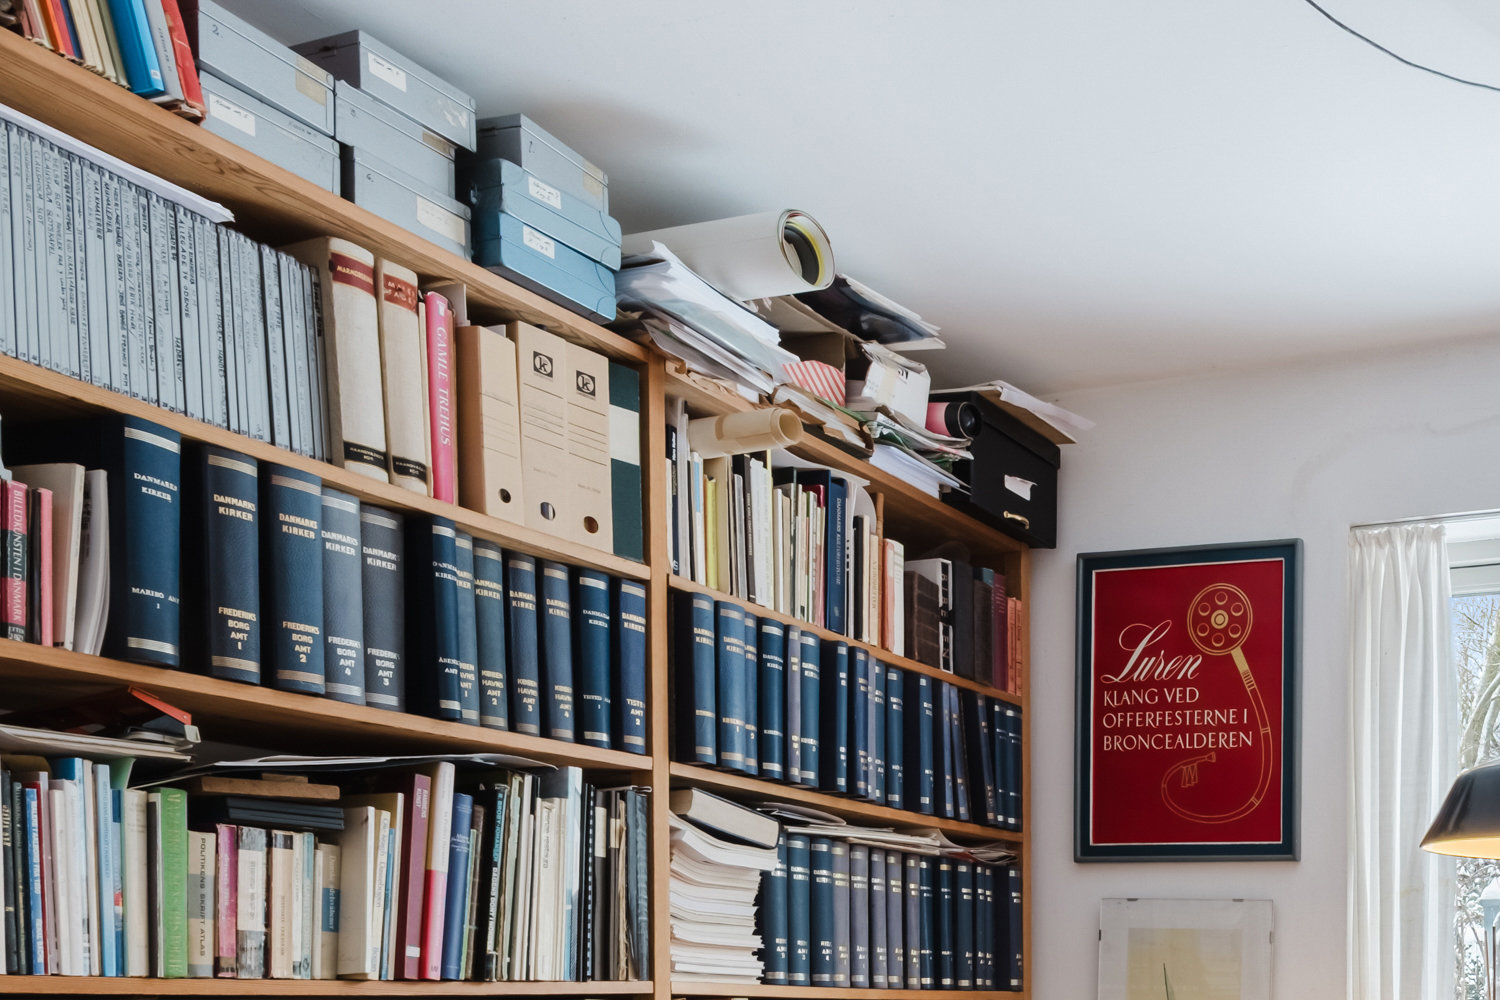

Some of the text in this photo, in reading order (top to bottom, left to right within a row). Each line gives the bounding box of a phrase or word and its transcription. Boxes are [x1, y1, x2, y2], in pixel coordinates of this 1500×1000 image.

[178, 219, 188, 266] ALLEGADE
[436, 326, 450, 446] GAMLE TREHUS
[134, 472, 178, 491] DANMARKS
[141, 486, 172, 502] KIRKER
[214, 494, 256, 512] DANMARKS
[219, 506, 253, 521] KIRKER
[12, 490, 24, 565] BILLEDKUNSTEN
[279, 513, 317, 529] DANMARKS
[282, 525, 315, 539] KIRKER
[321, 530, 358, 546] DANMARKS
[326, 542, 355, 556] KIRKER
[367, 557, 397, 571] KIRKER
[12, 573, 23, 621] DANMARK
[131, 587, 164, 599] MARIBO
[219, 606, 256, 621] FREDERIKS
[228, 620, 250, 631] BORG
[283, 621, 319, 635] FREDERIKS
[231, 630, 248, 641] AMT
[292, 633, 313, 644] BORG
[294, 644, 312, 654] AMT
[337, 648, 356, 658] BORG
[1100, 620, 1202, 683] Luren
[300, 654, 306, 663] 2
[339, 658, 355, 668] AMT
[376, 659, 395, 669] BORG
[378, 669, 393, 678] AMT
[487, 689, 501, 697] AMT
[1104, 687, 1199, 708] KLANG VED
[523, 697, 536, 705] AMT
[1103, 709, 1248, 728] OFFERFESTERNE I
[1104, 731, 1252, 751] BRONCEALDEREN
